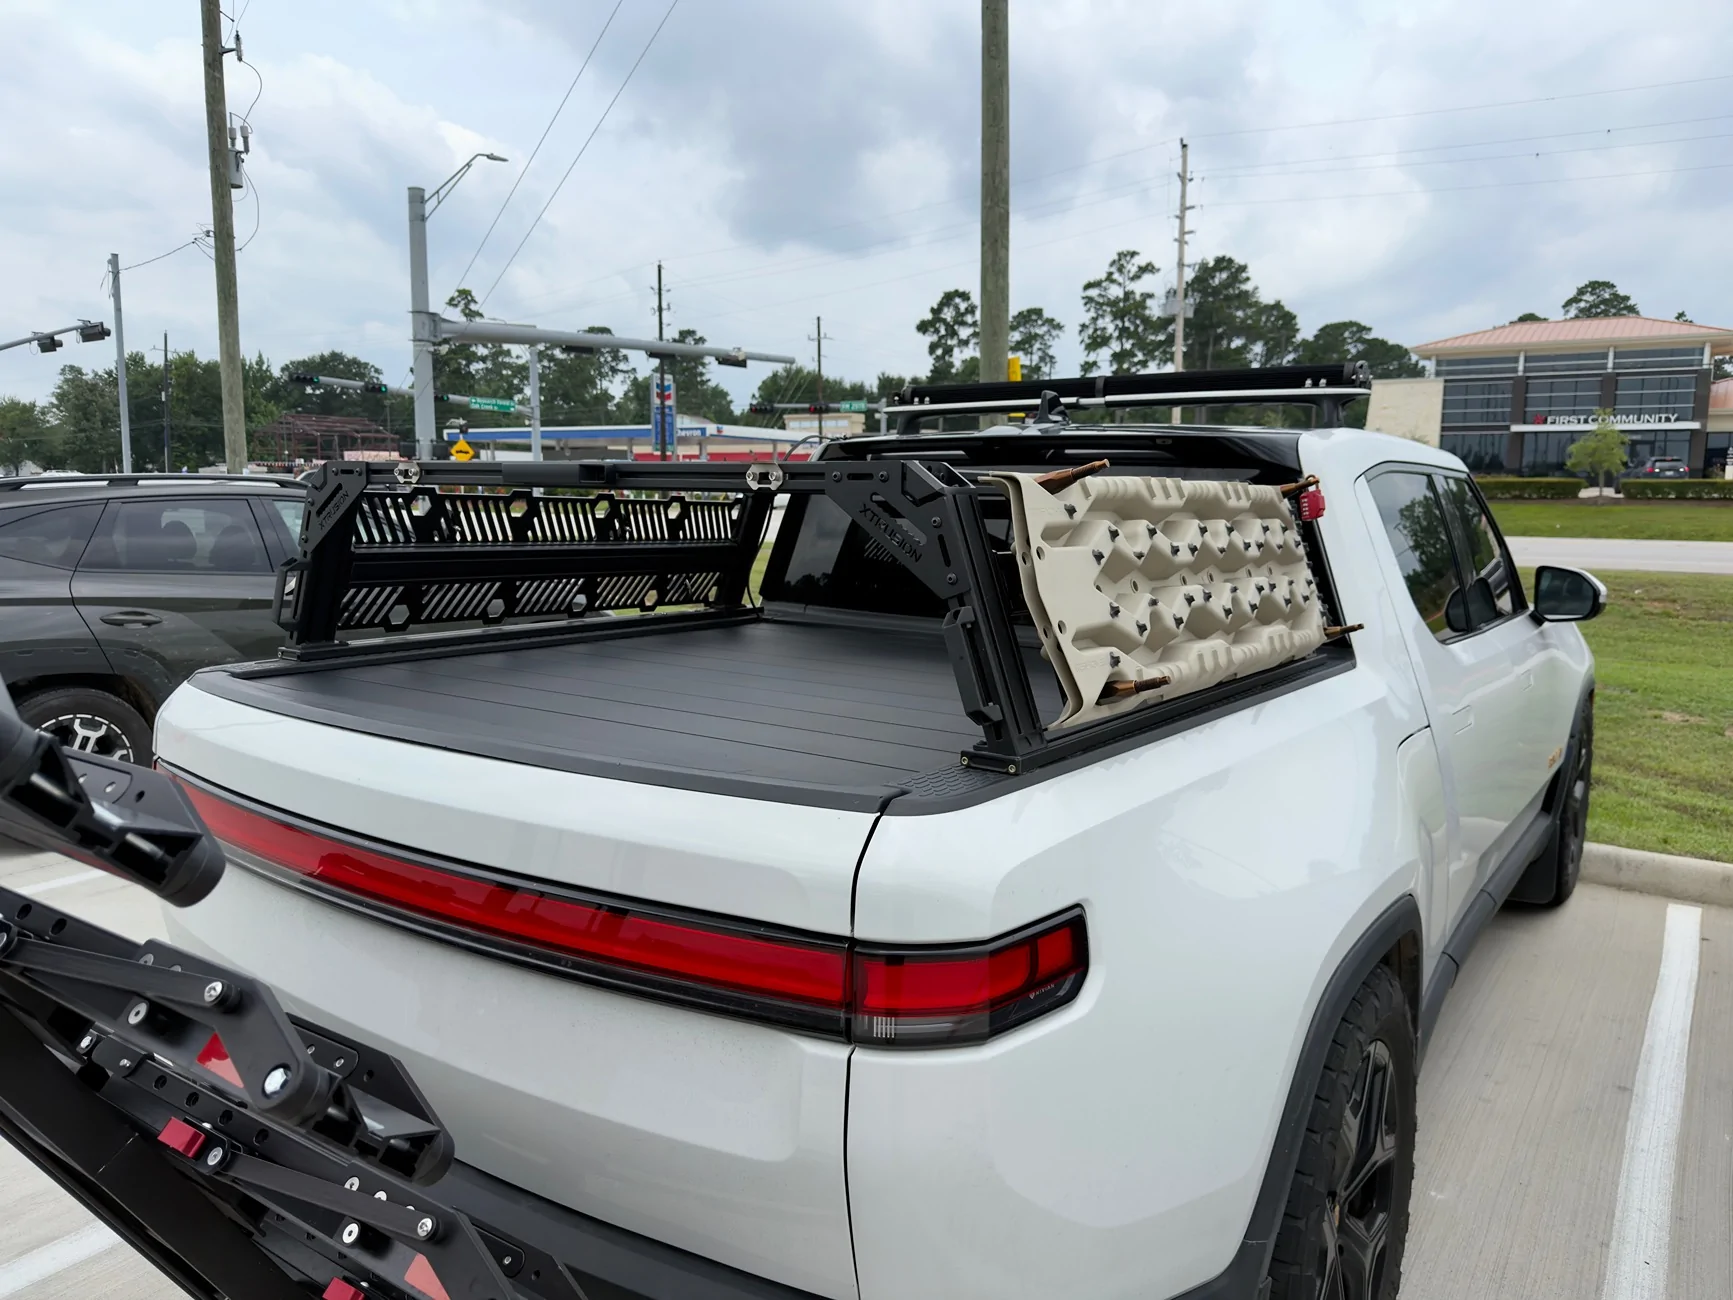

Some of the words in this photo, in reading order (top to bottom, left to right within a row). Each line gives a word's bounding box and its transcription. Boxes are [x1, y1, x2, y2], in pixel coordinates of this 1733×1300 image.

[1546, 415, 1587, 425] FIRST
[1588, 413, 1679, 425] COMMUNITY
[318, 490, 350, 531] XTRUSION
[859, 503, 923, 563] XTRUSION
